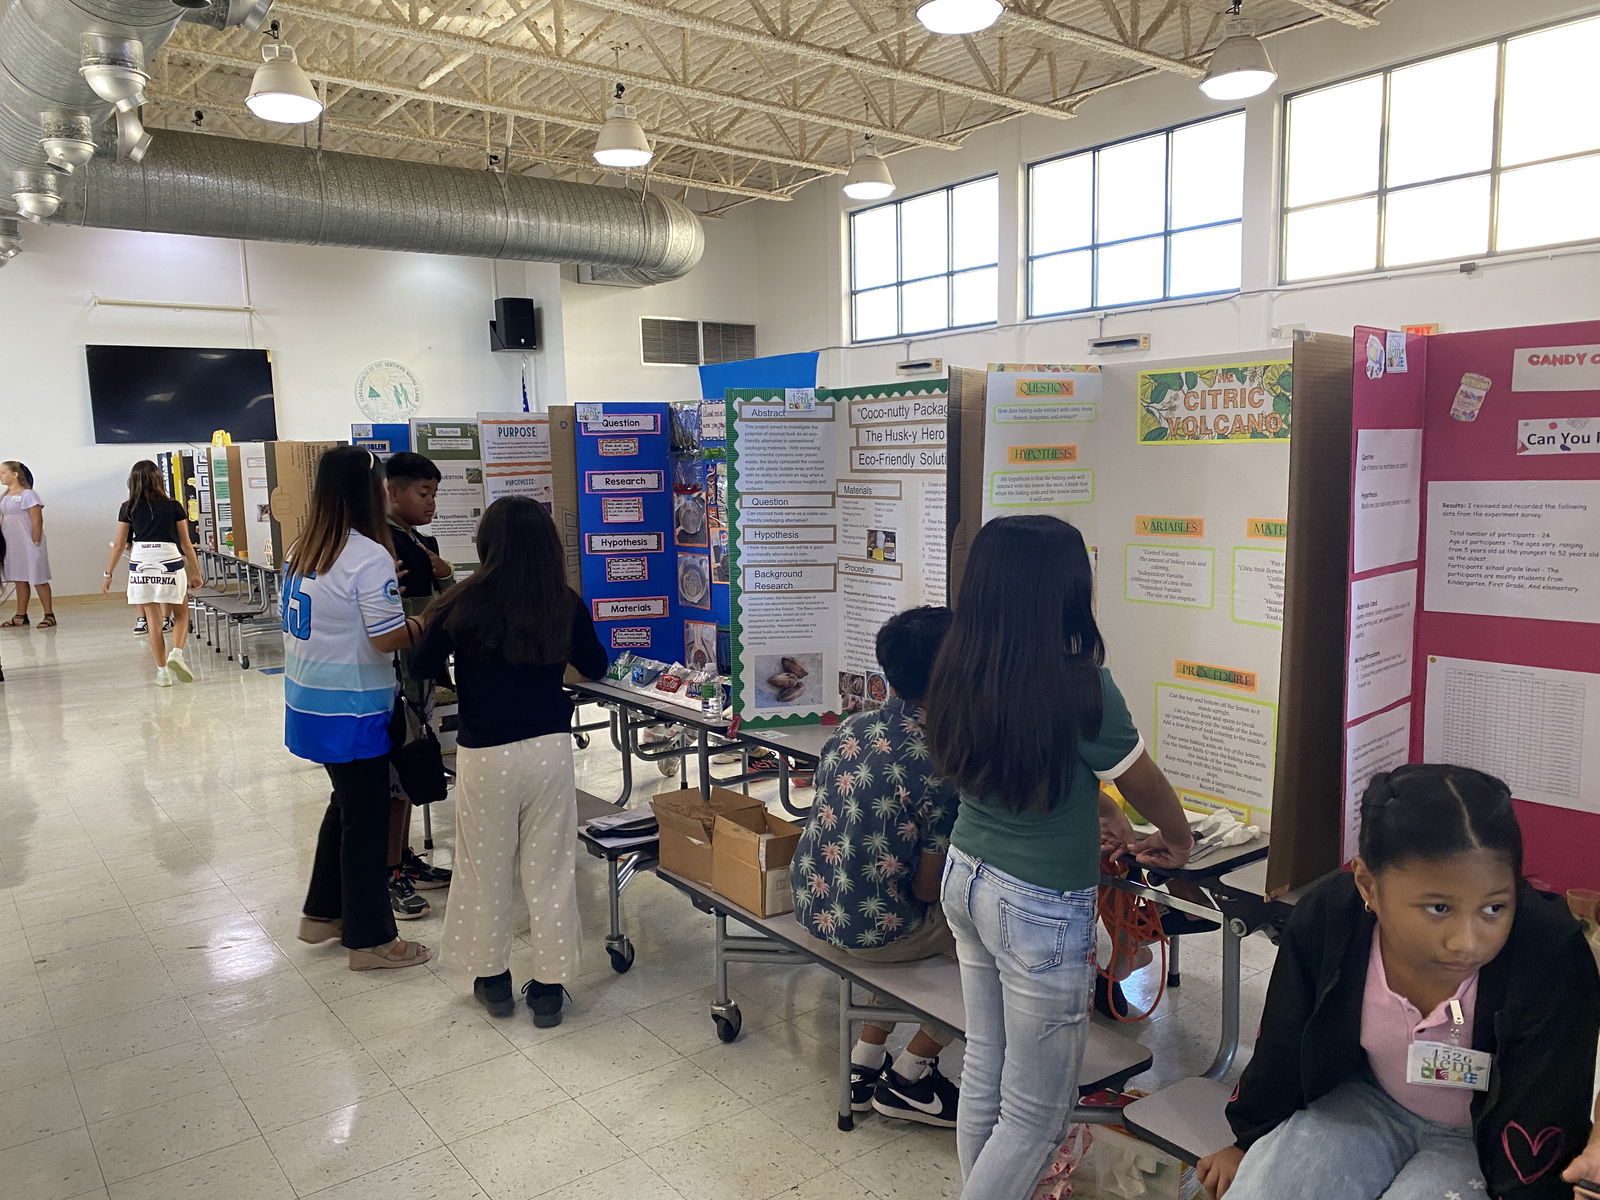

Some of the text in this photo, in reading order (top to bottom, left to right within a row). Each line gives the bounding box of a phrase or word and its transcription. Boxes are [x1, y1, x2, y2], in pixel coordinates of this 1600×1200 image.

[1528, 353, 1588, 366] CANDY
[1212, 372, 1234, 383] THE
[1020, 382, 1070, 395] QUESTION
[1184, 387, 1264, 411] CITRIC
[752, 408, 786, 417] Abstract
[602, 419, 640, 428] Question
[1167, 412, 1283, 436] VOLCANO
[498, 426, 536, 438] PURPOSE
[866, 428, 944, 444] The Husk-y Hero
[1527, 432, 1590, 445] Can You
[1015, 449, 1072, 460] HYPOTHESIS
[858, 453, 916, 468] Eco-Friendly
[605, 478, 646, 486] Research
[844, 486, 872, 494] Materials
[752, 498, 789, 506] Question
[1558, 503, 1587, 511] following
[1142, 522, 1198, 533] VARIABLES
[754, 531, 799, 540] Hypothesis
[600, 538, 648, 548] Hypothesis
[844, 564, 874, 574] Procedure
[754, 570, 803, 580] Background
[130, 576, 176, 586] CALIFORNIA
[754, 582, 794, 590] Research
[610, 604, 652, 614] Materials
[1182, 664, 1250, 686] PROCEDURE
[1236, 705, 1250, 713] lemon
[1423, 1057, 1472, 1074] stem
